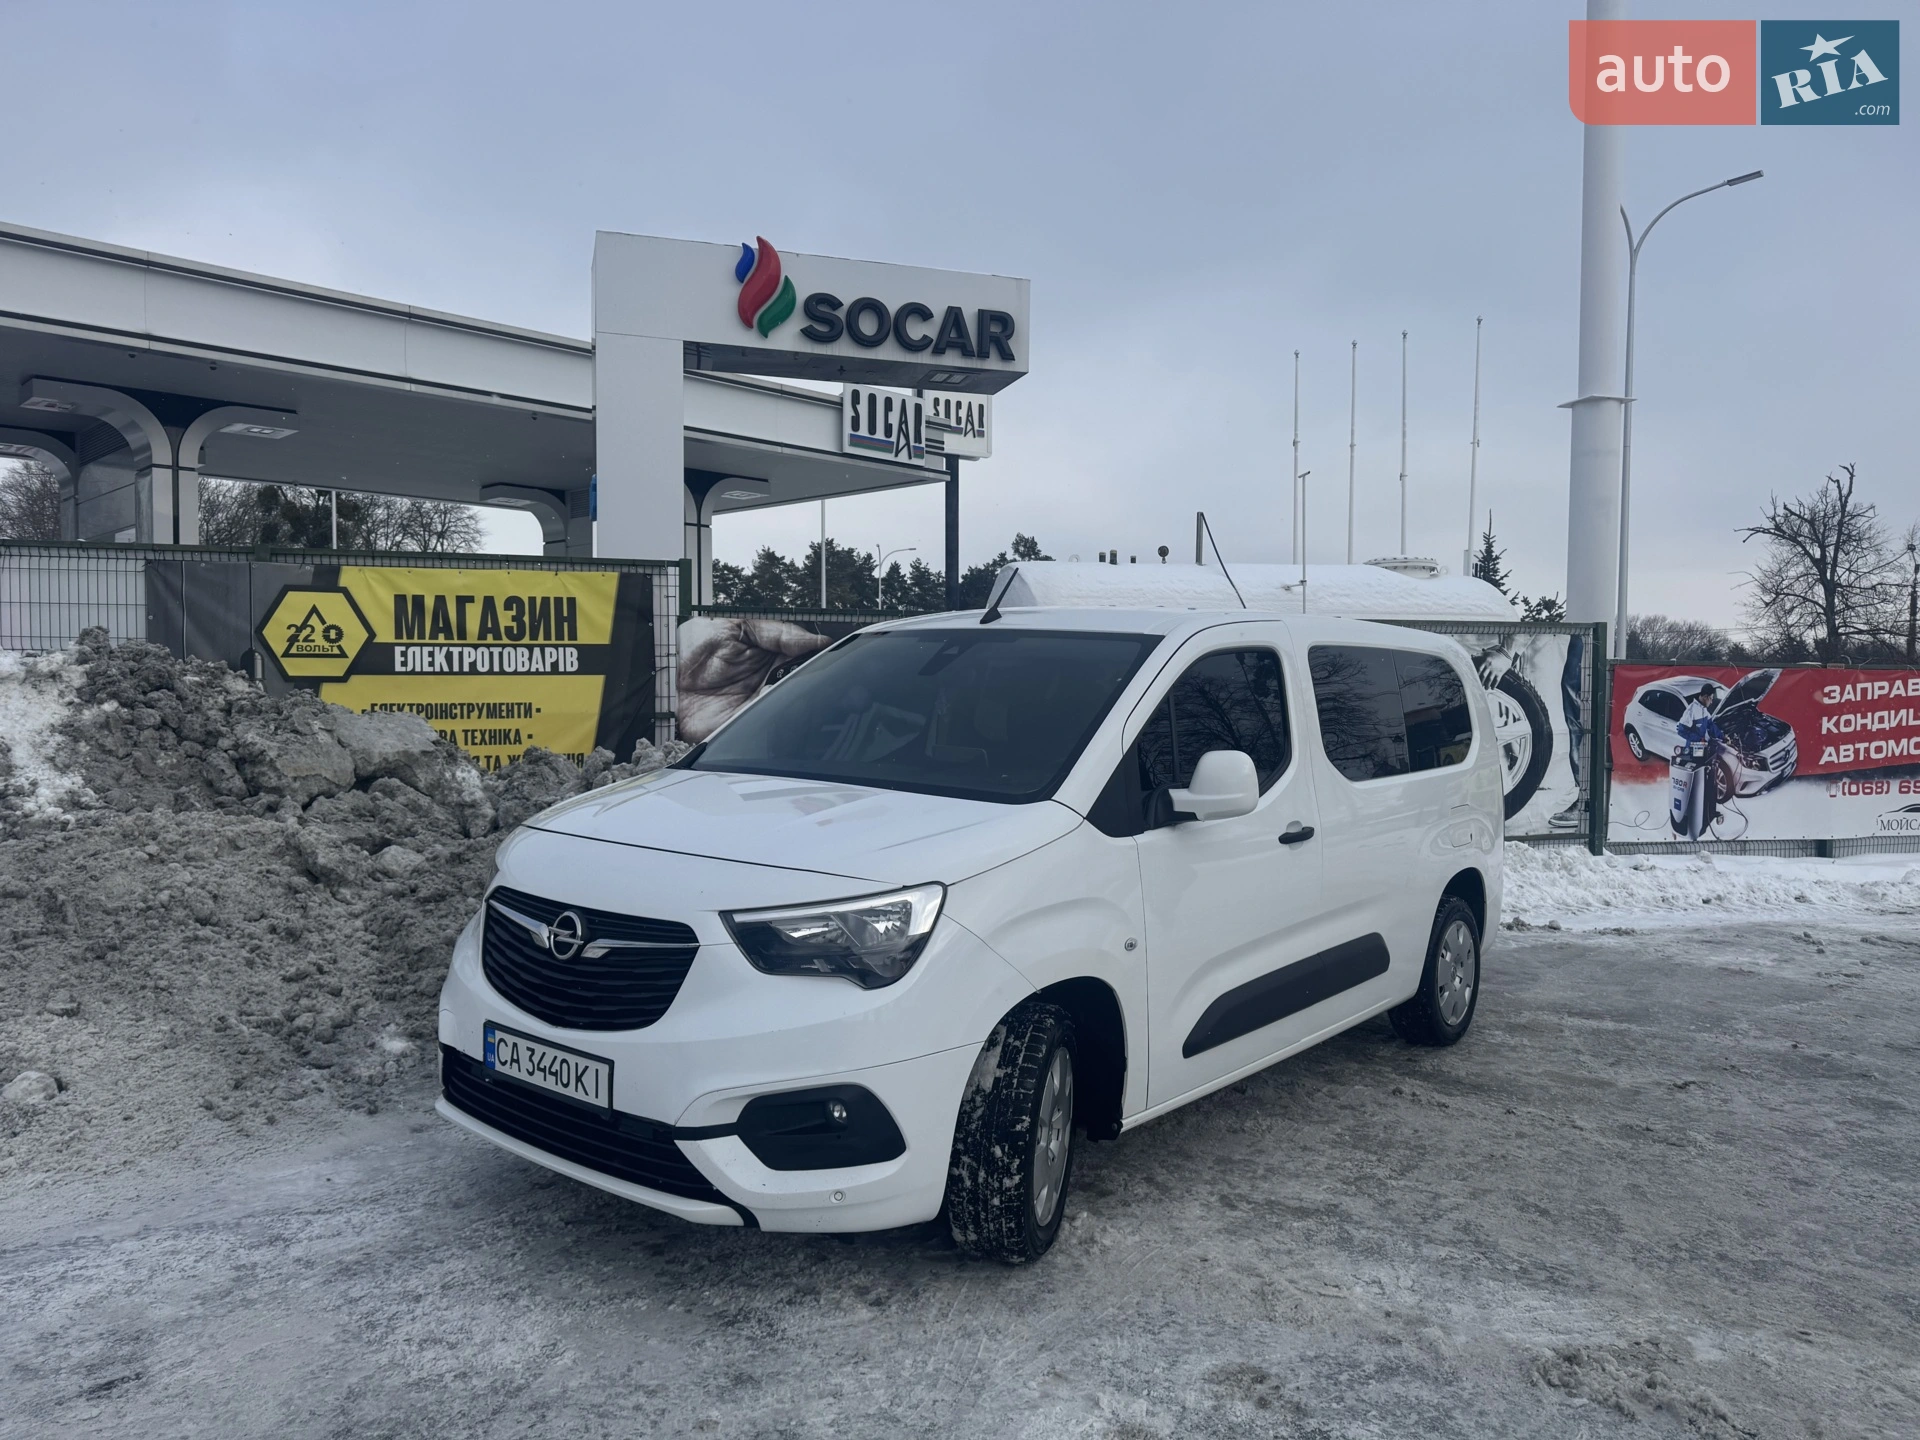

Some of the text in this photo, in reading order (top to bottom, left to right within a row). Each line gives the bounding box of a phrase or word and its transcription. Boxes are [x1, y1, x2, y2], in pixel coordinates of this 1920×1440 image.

[800, 292, 1016, 362] SOCAR
[851, 388, 922, 460] SOCAR
[933, 397, 985, 438] SOCAR
[393, 593, 578, 642] МАГАЗИН
[296, 644, 336, 653] ВОЛЬТ
[394, 645, 579, 673] ЕЛЕКТРОТОВАРІВ
[462, 728, 523, 746] ТЕХНІКА
[1841, 780, 1891, 797] (068)
[1879, 816, 1920, 831] МОЙС
